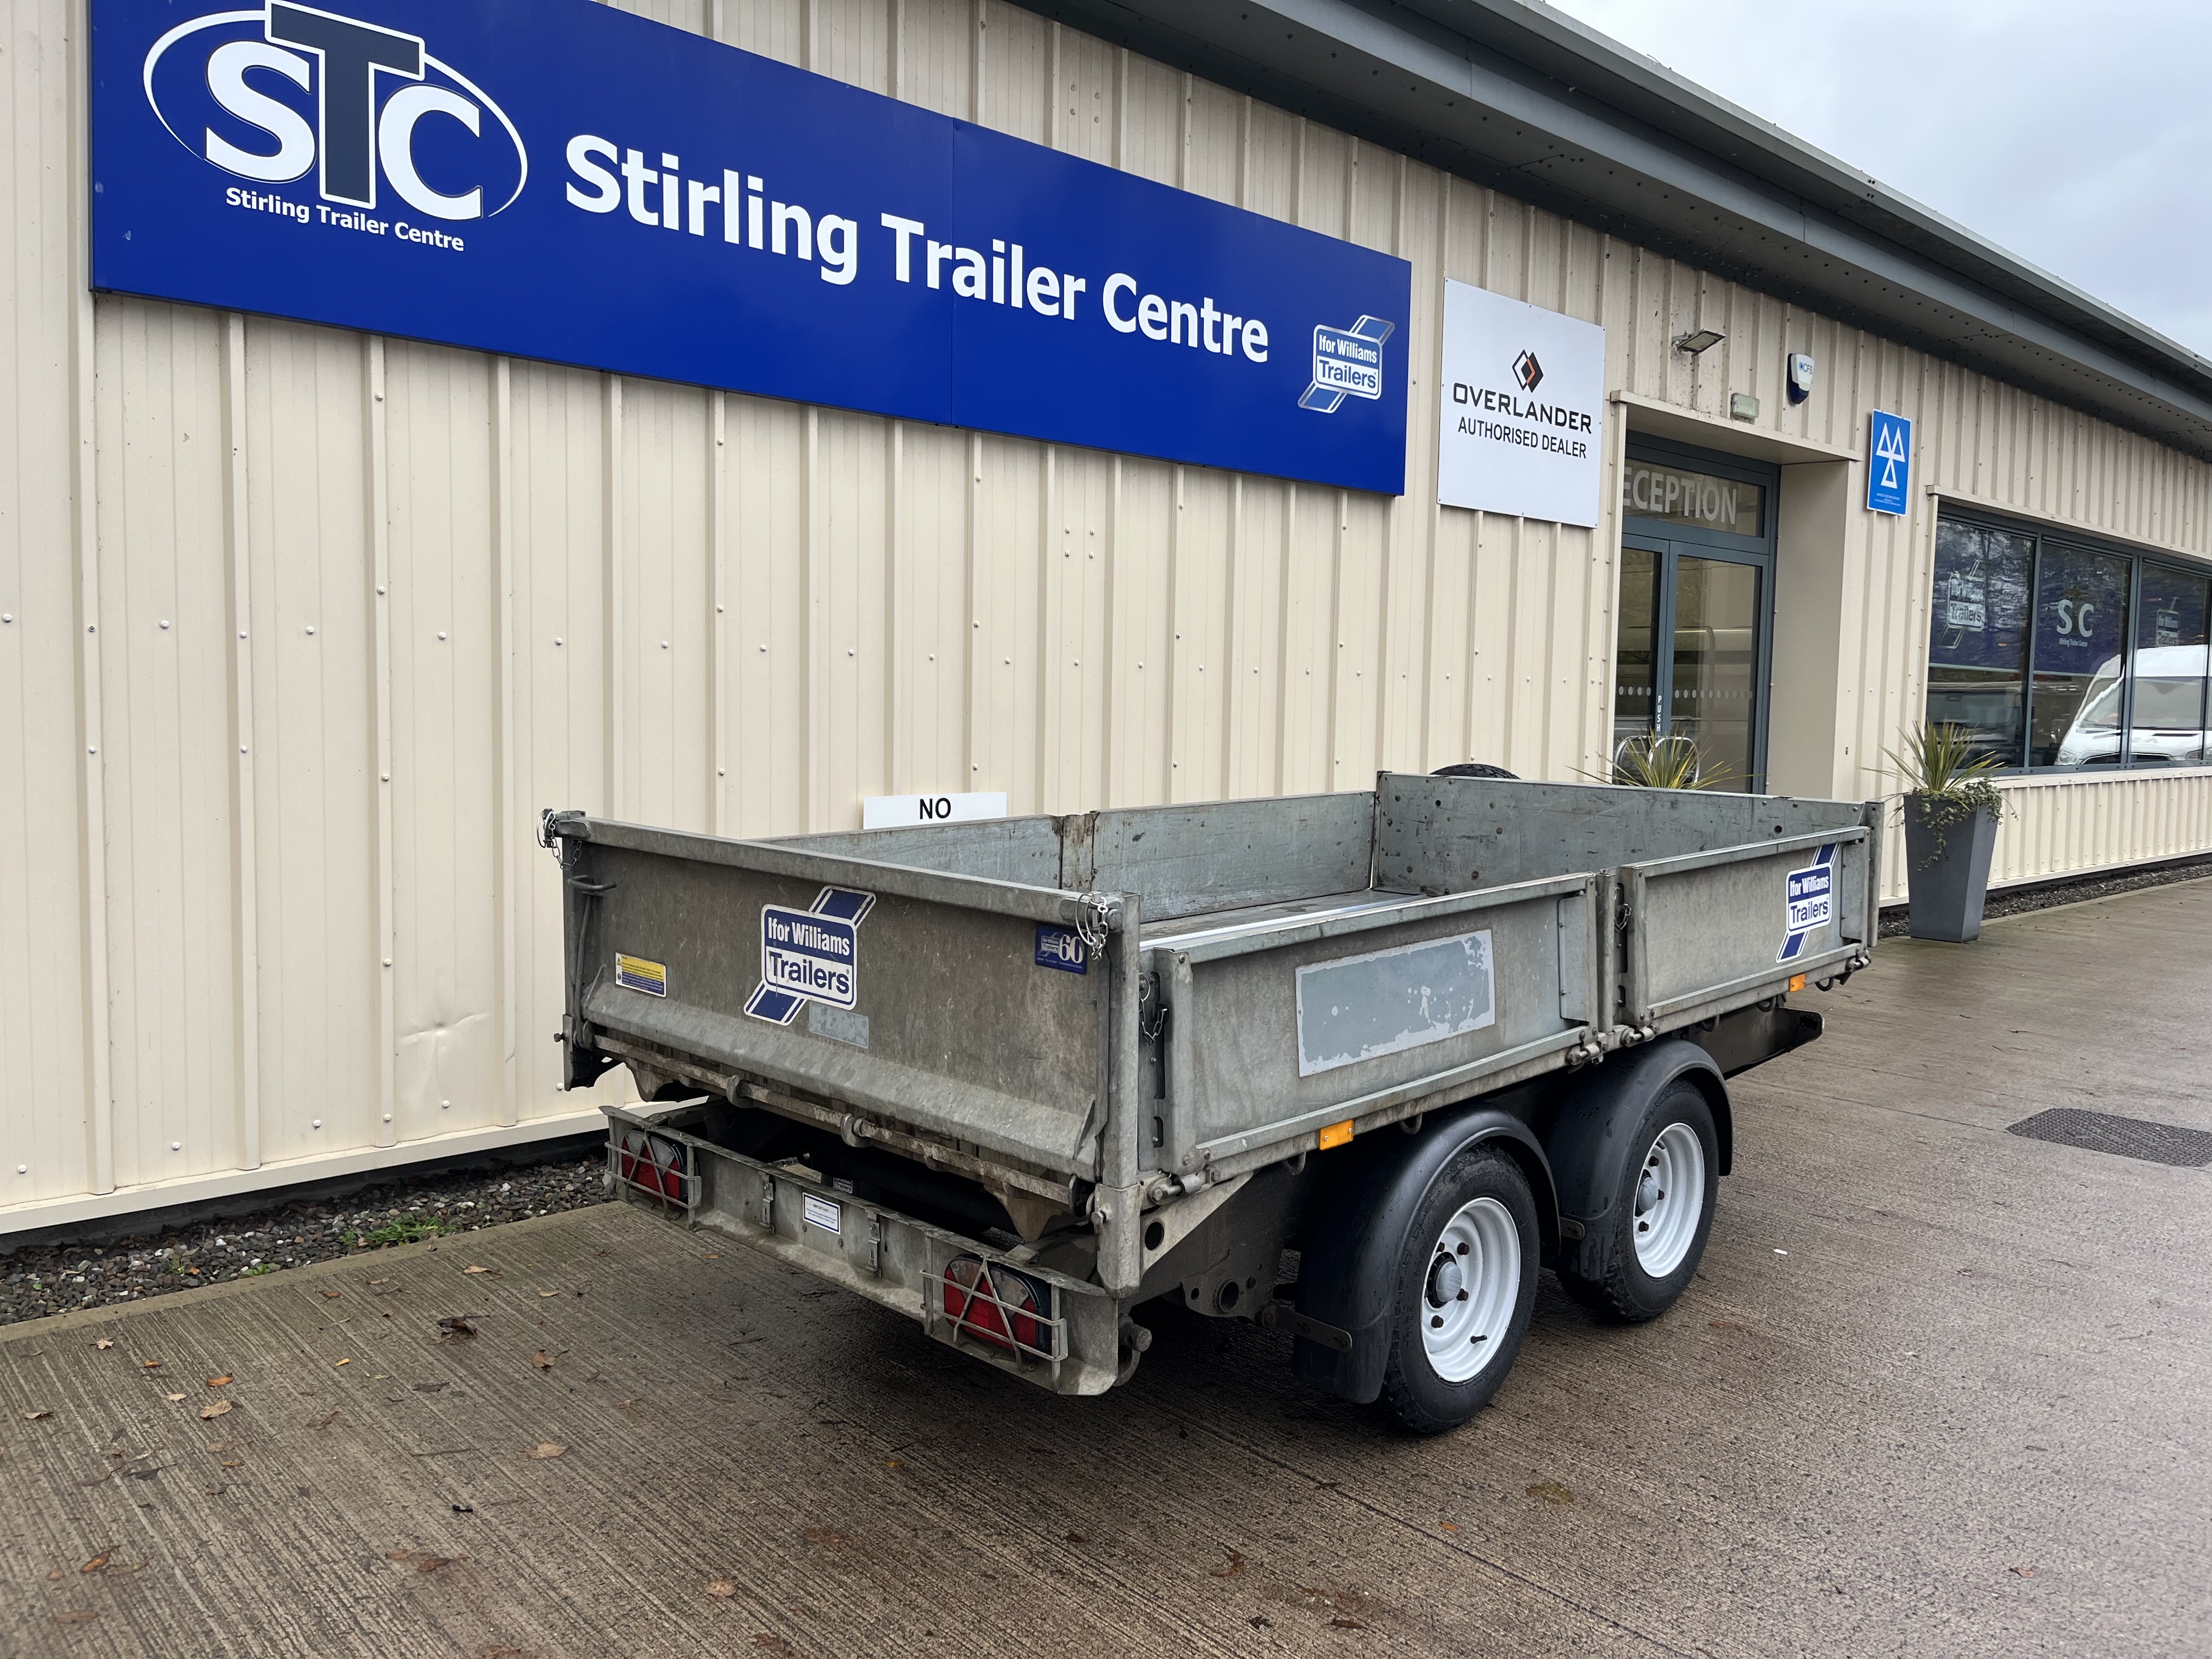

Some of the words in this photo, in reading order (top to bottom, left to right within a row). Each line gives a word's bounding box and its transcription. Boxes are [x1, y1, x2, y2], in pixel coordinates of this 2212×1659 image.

[205, 0, 483, 220] STC
[226, 187, 309, 223] Stirling
[316, 205, 389, 235] Trailer
[394, 222, 464, 251] Centre
[566, 135, 857, 285] Stirling
[881, 213, 1086, 320] Trailer
[1103, 273, 1268, 363] Centre
[1319, 335, 1336, 353] Ifor
[1337, 338, 1377, 364] Williams
[1319, 359, 1376, 388] Trailers
[1453, 382, 1592, 434] OVERLANDER
[1458, 417, 1538, 448] AUTHORISED
[1542, 434, 1587, 459] DEALER
[919, 797, 951, 820] NO
[1790, 880, 1802, 897] Ifor
[1802, 876, 1830, 894] Williams
[1790, 901, 1829, 924] Trailers
[768, 917, 790, 942] Ifor
[791, 922, 850, 956] Williams
[1059, 934, 1084, 963] 60
[769, 951, 849, 994] Trailers
